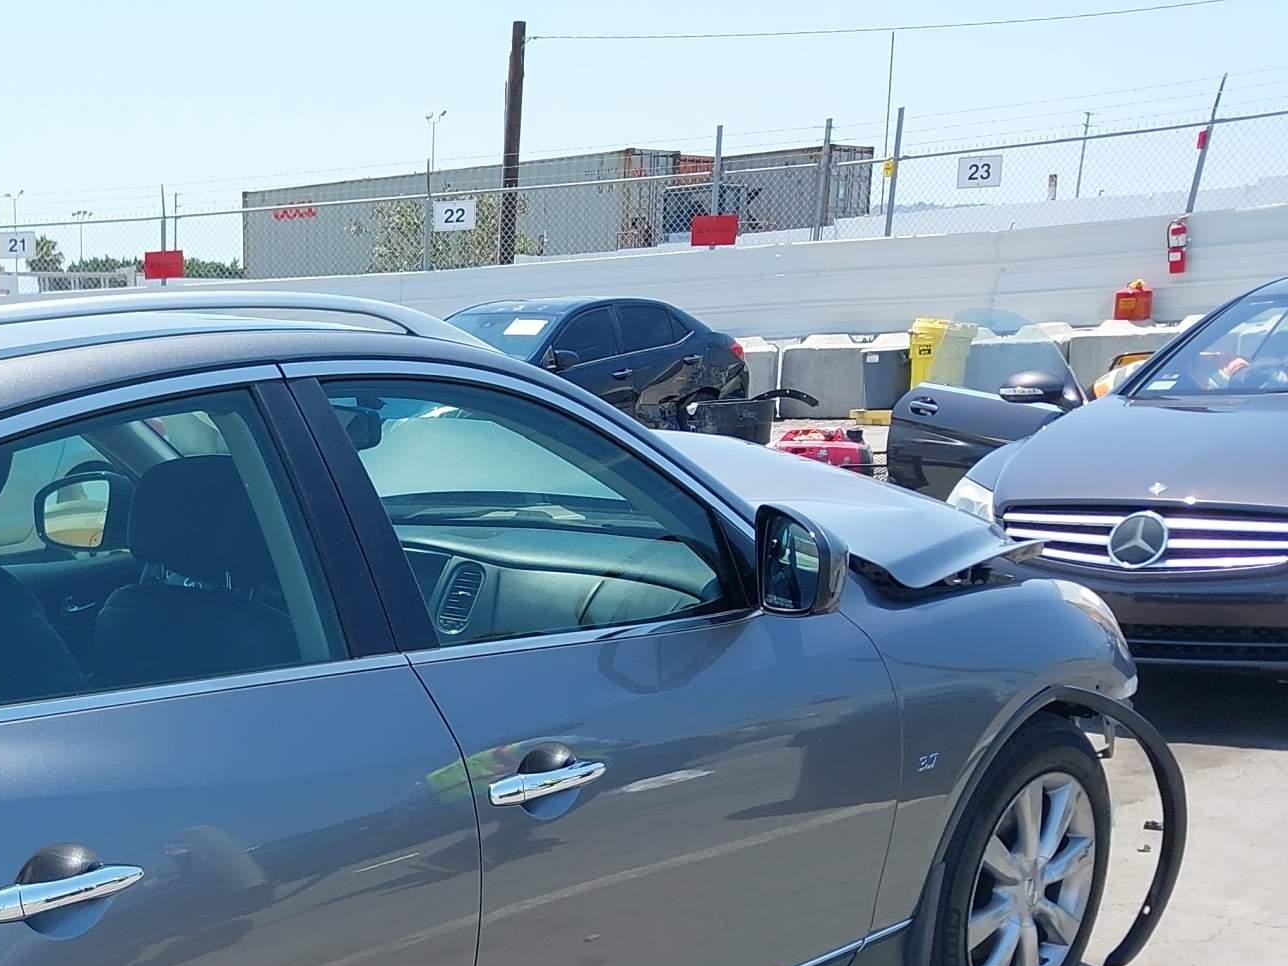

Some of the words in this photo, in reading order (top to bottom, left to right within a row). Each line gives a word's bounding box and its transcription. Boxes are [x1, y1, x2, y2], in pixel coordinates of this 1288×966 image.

[967, 163, 991, 181] 23
[443, 207, 466, 224] 22
[8, 237, 29, 253] 21
